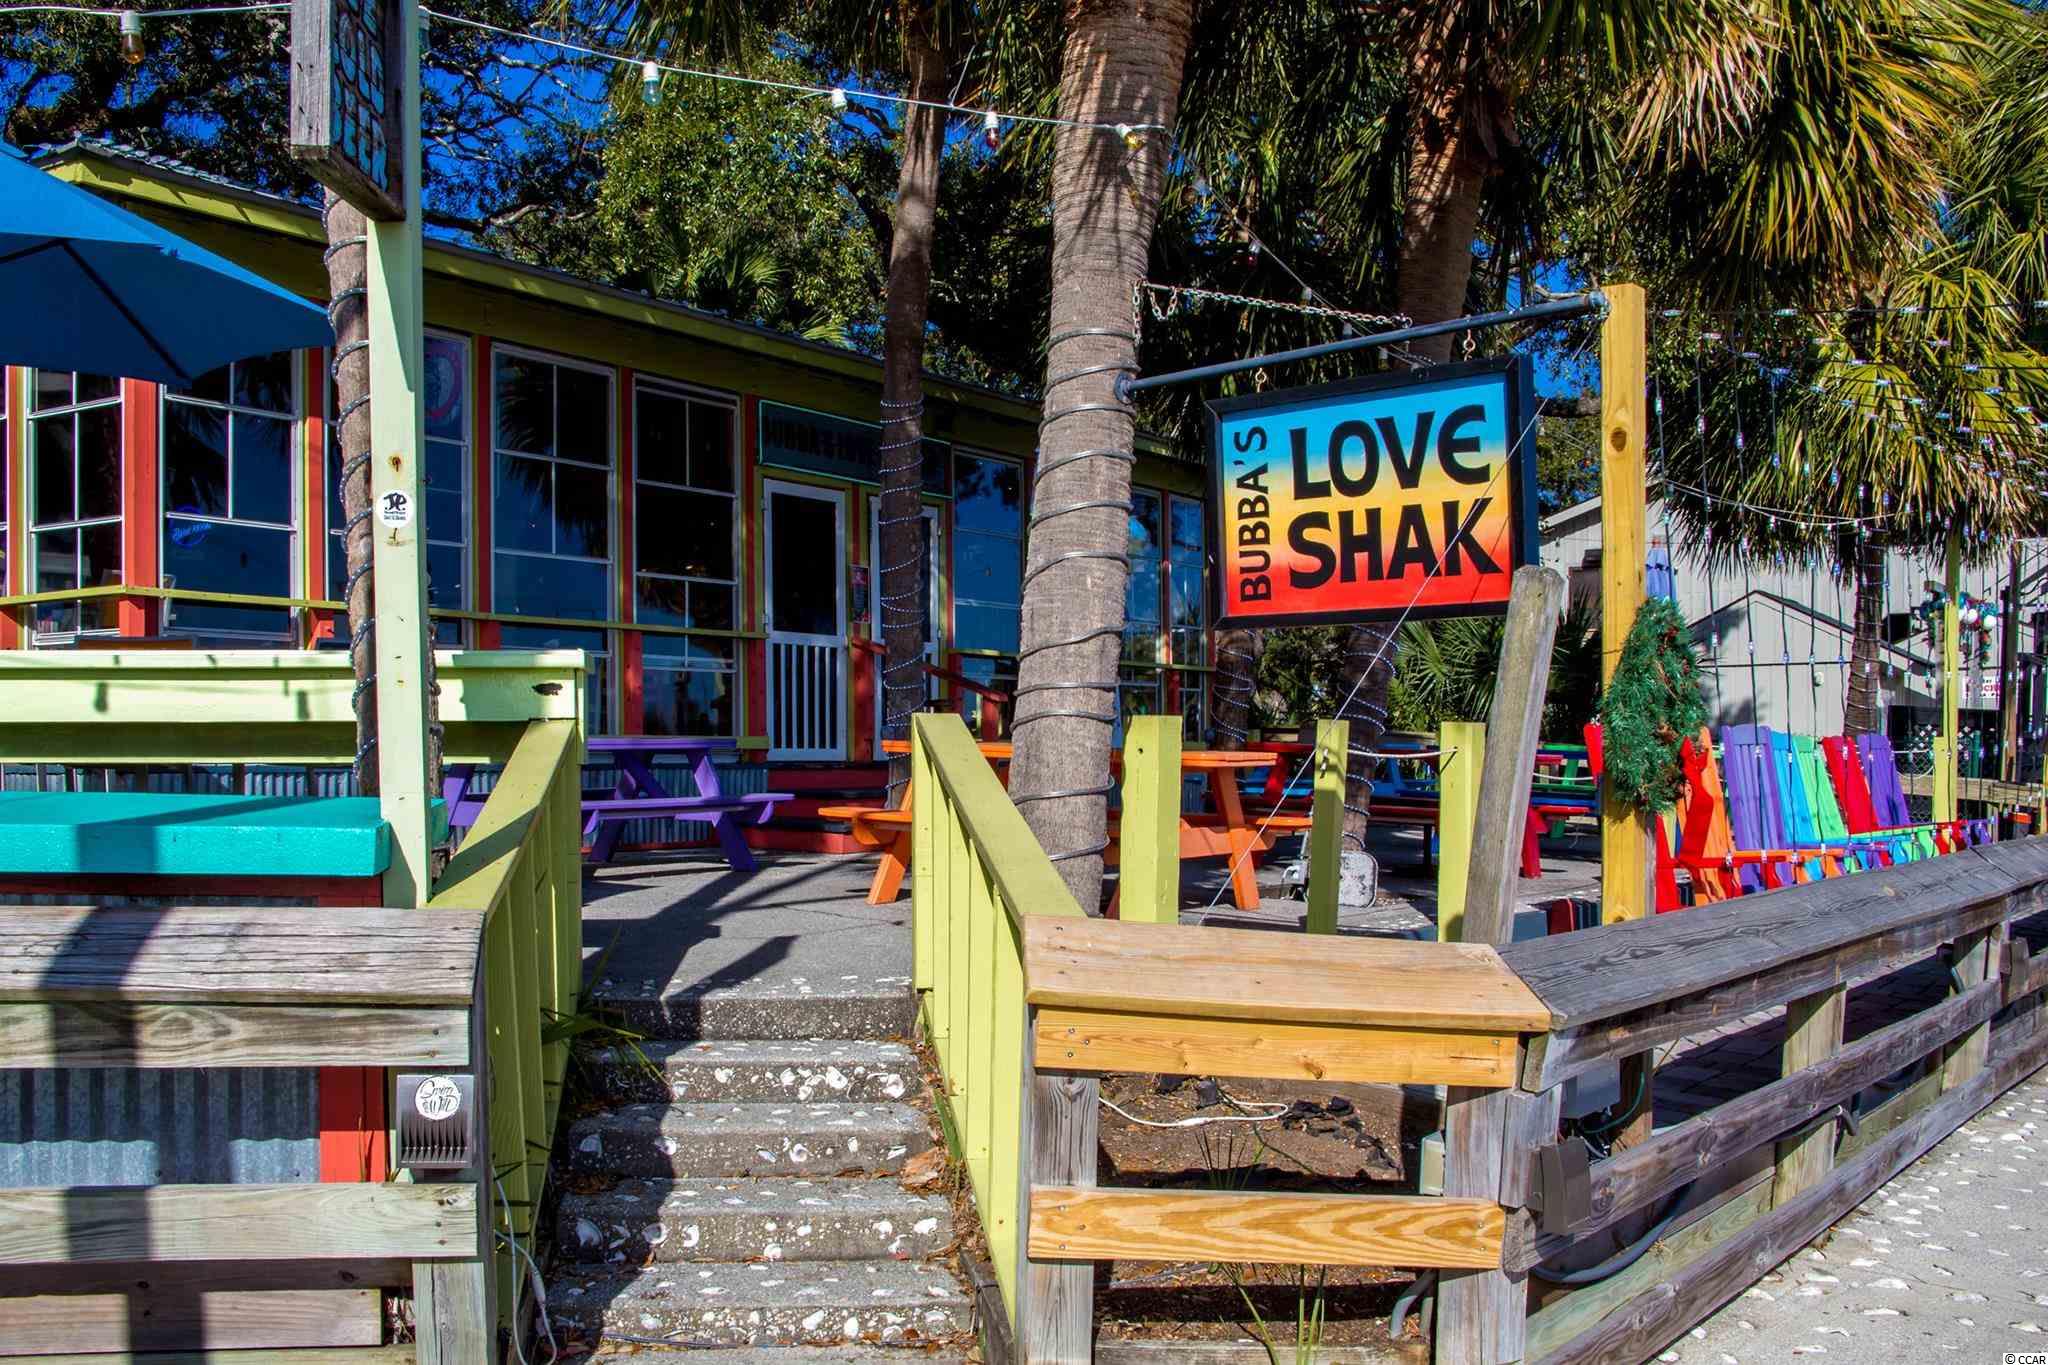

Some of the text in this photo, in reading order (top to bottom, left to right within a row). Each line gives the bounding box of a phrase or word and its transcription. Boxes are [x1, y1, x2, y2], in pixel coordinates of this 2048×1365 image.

[1288, 404, 1491, 501] LOVE
[1233, 425, 1273, 602] BUBBA'S
[1287, 497, 1504, 590] SHAK
